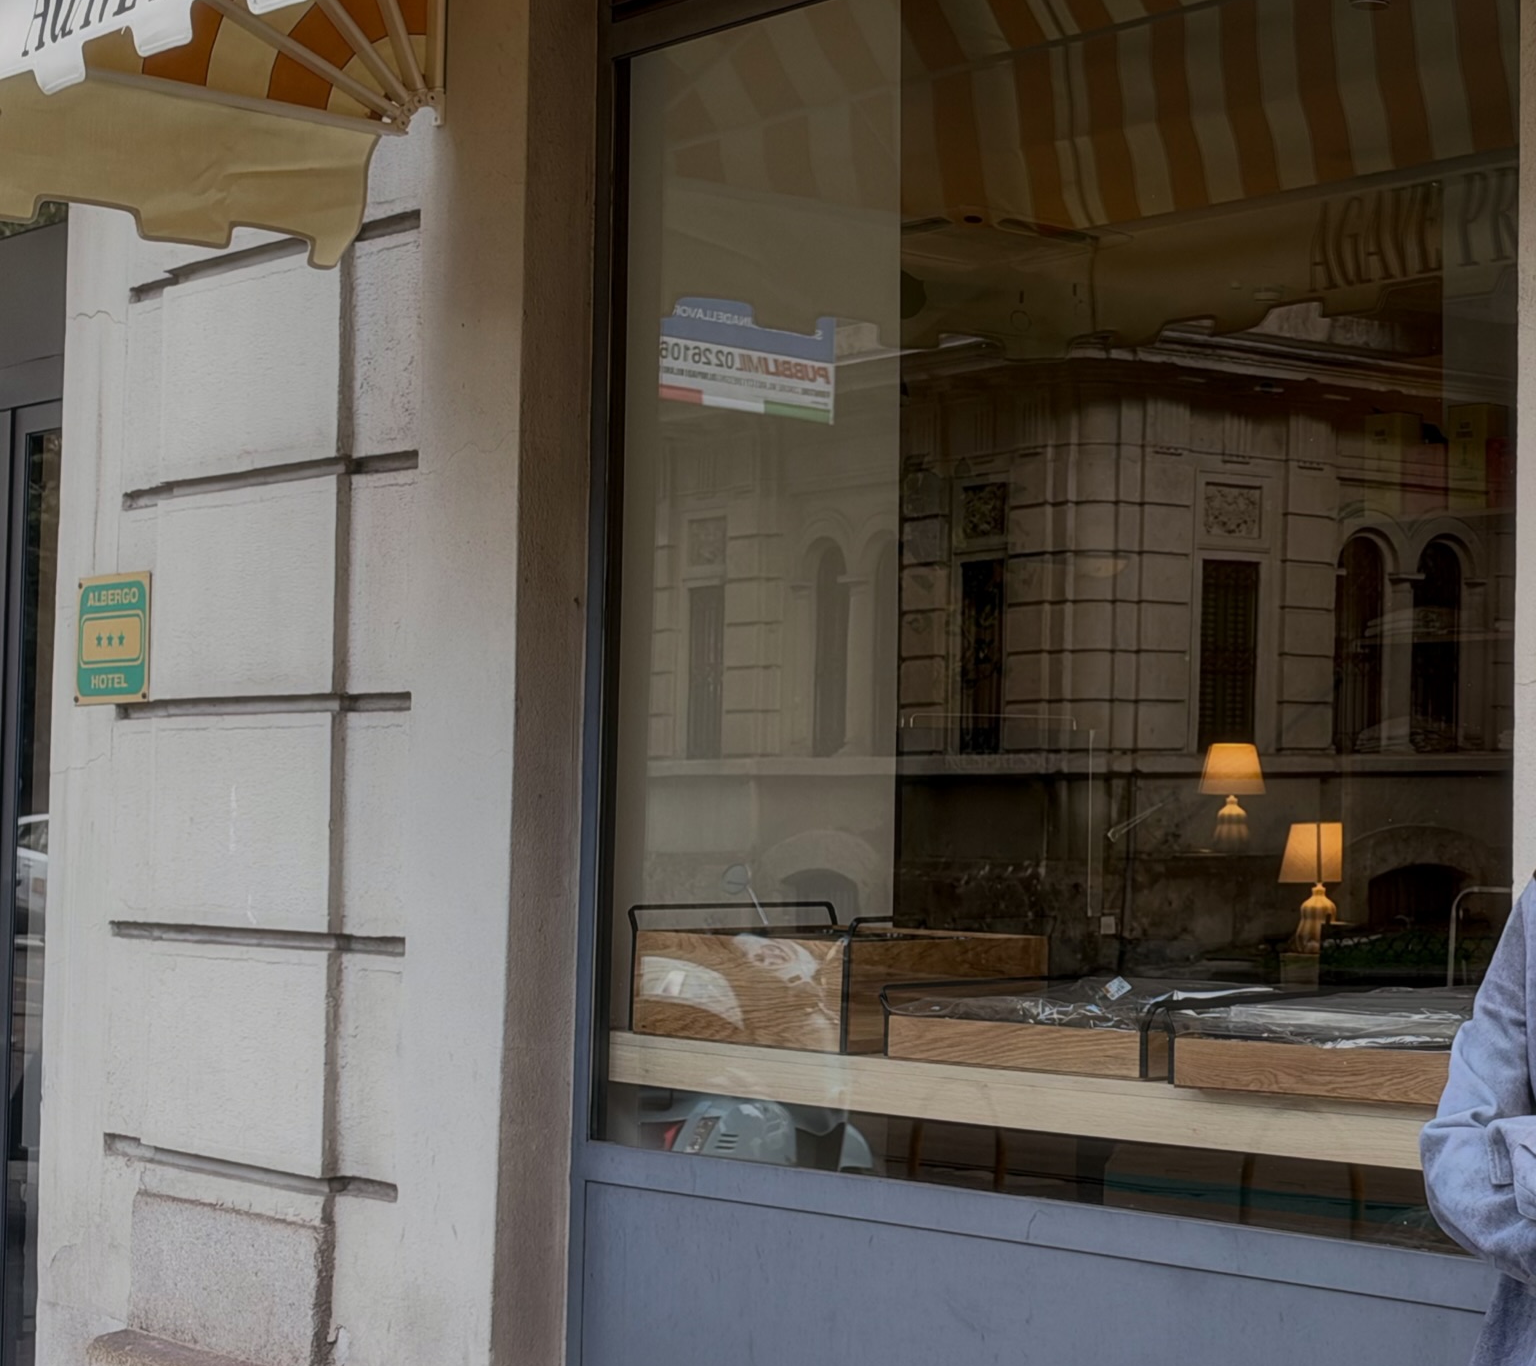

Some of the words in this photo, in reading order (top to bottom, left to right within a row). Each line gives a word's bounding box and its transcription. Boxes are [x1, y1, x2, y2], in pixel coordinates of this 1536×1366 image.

[1307, 181, 1443, 293] AGAVE
[87, 587, 139, 607] ALBERGO
[90, 673, 128, 689] HOTEL
